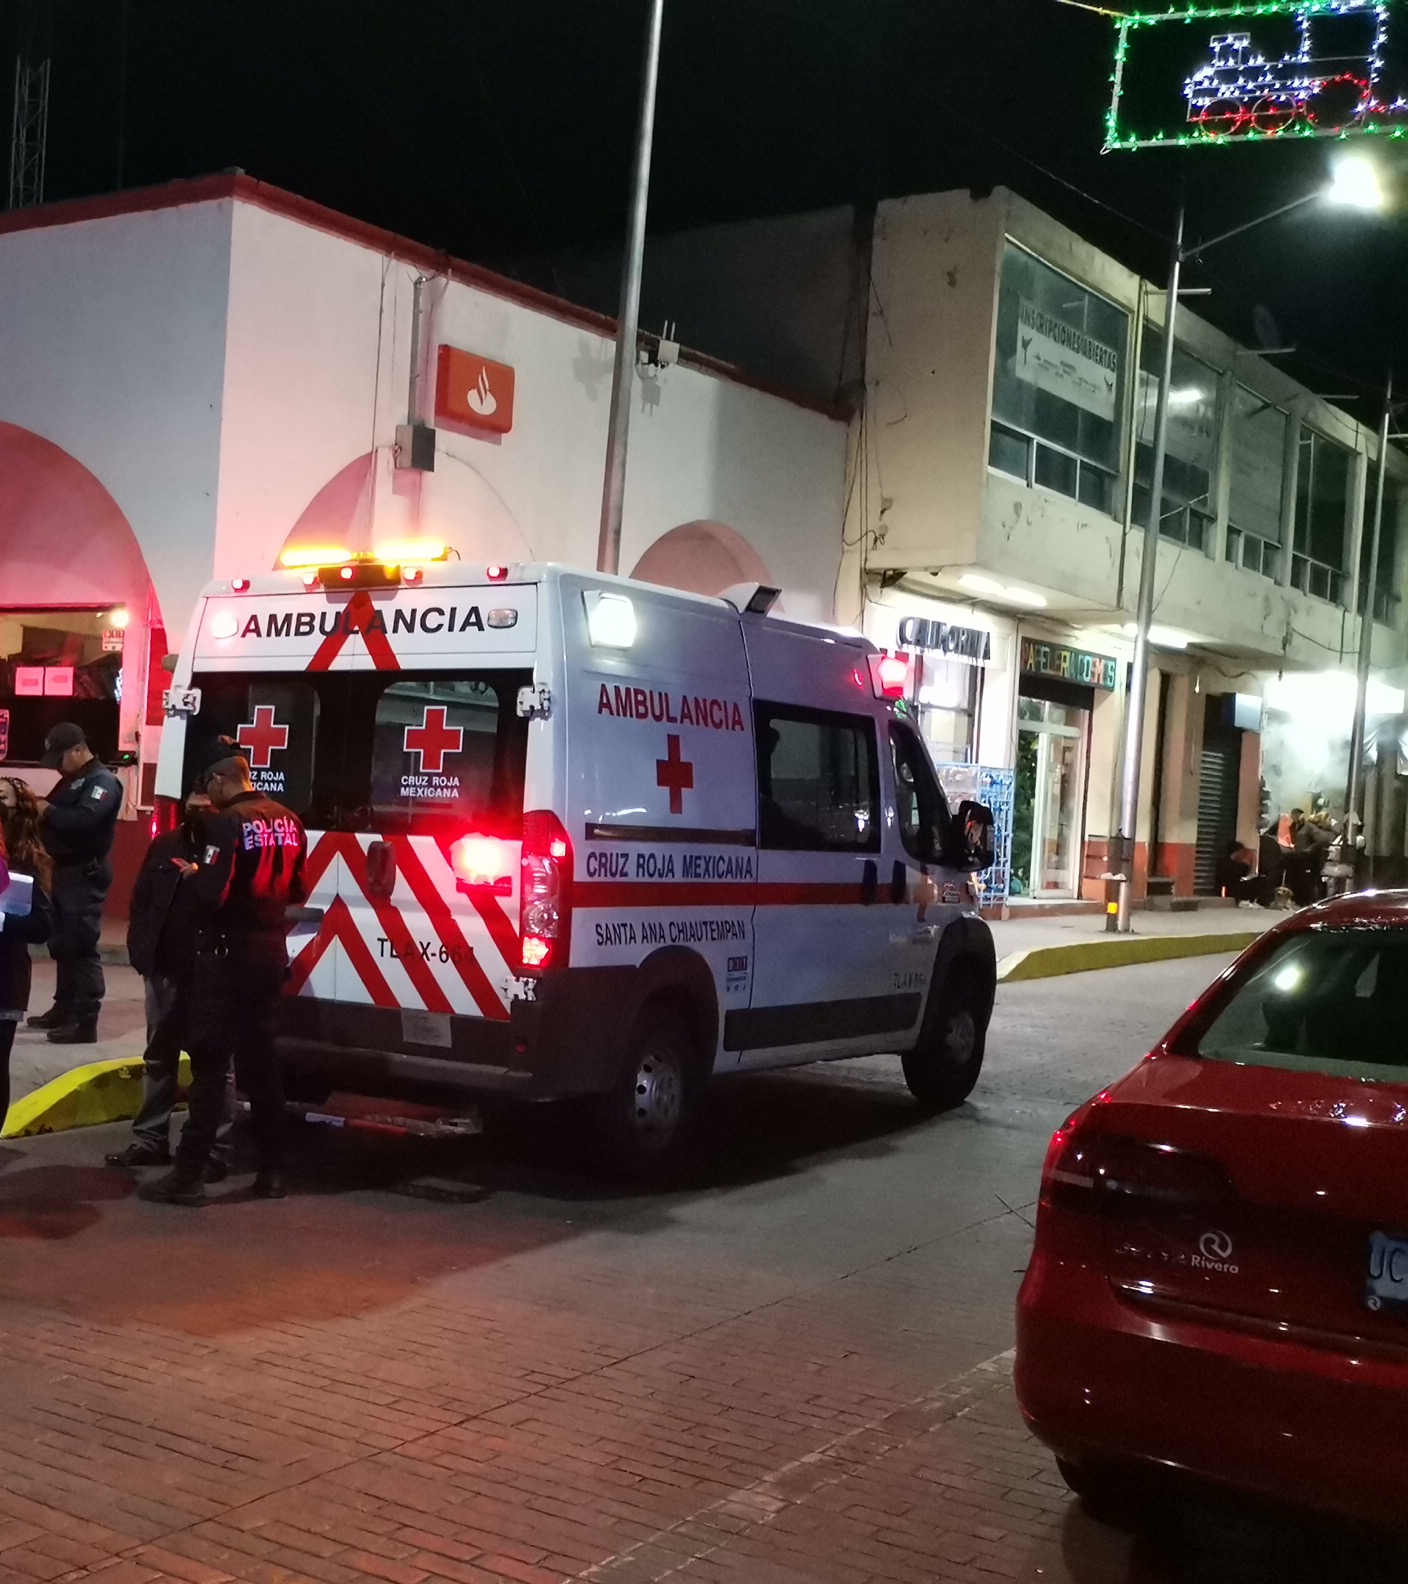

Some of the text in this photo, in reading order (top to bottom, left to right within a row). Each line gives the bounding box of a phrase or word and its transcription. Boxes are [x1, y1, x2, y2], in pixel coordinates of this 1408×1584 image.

[240, 606, 485, 639] AMBULANCIA
[597, 685, 745, 732] AMBULANCIA
[260, 771, 285, 781] ROJA
[400, 775, 460, 787] CRUZ ROJA
[251, 781, 285, 792] ICANA
[400, 786, 459, 798] MEXICANA
[243, 832, 298, 851] ESTATAL
[586, 851, 753, 880] CRUZ ROJA MEXICANA
[595, 919, 746, 946] SANTA ANA CHIAUTEMPAN
[1191, 1254, 1240, 1274] Rivera
